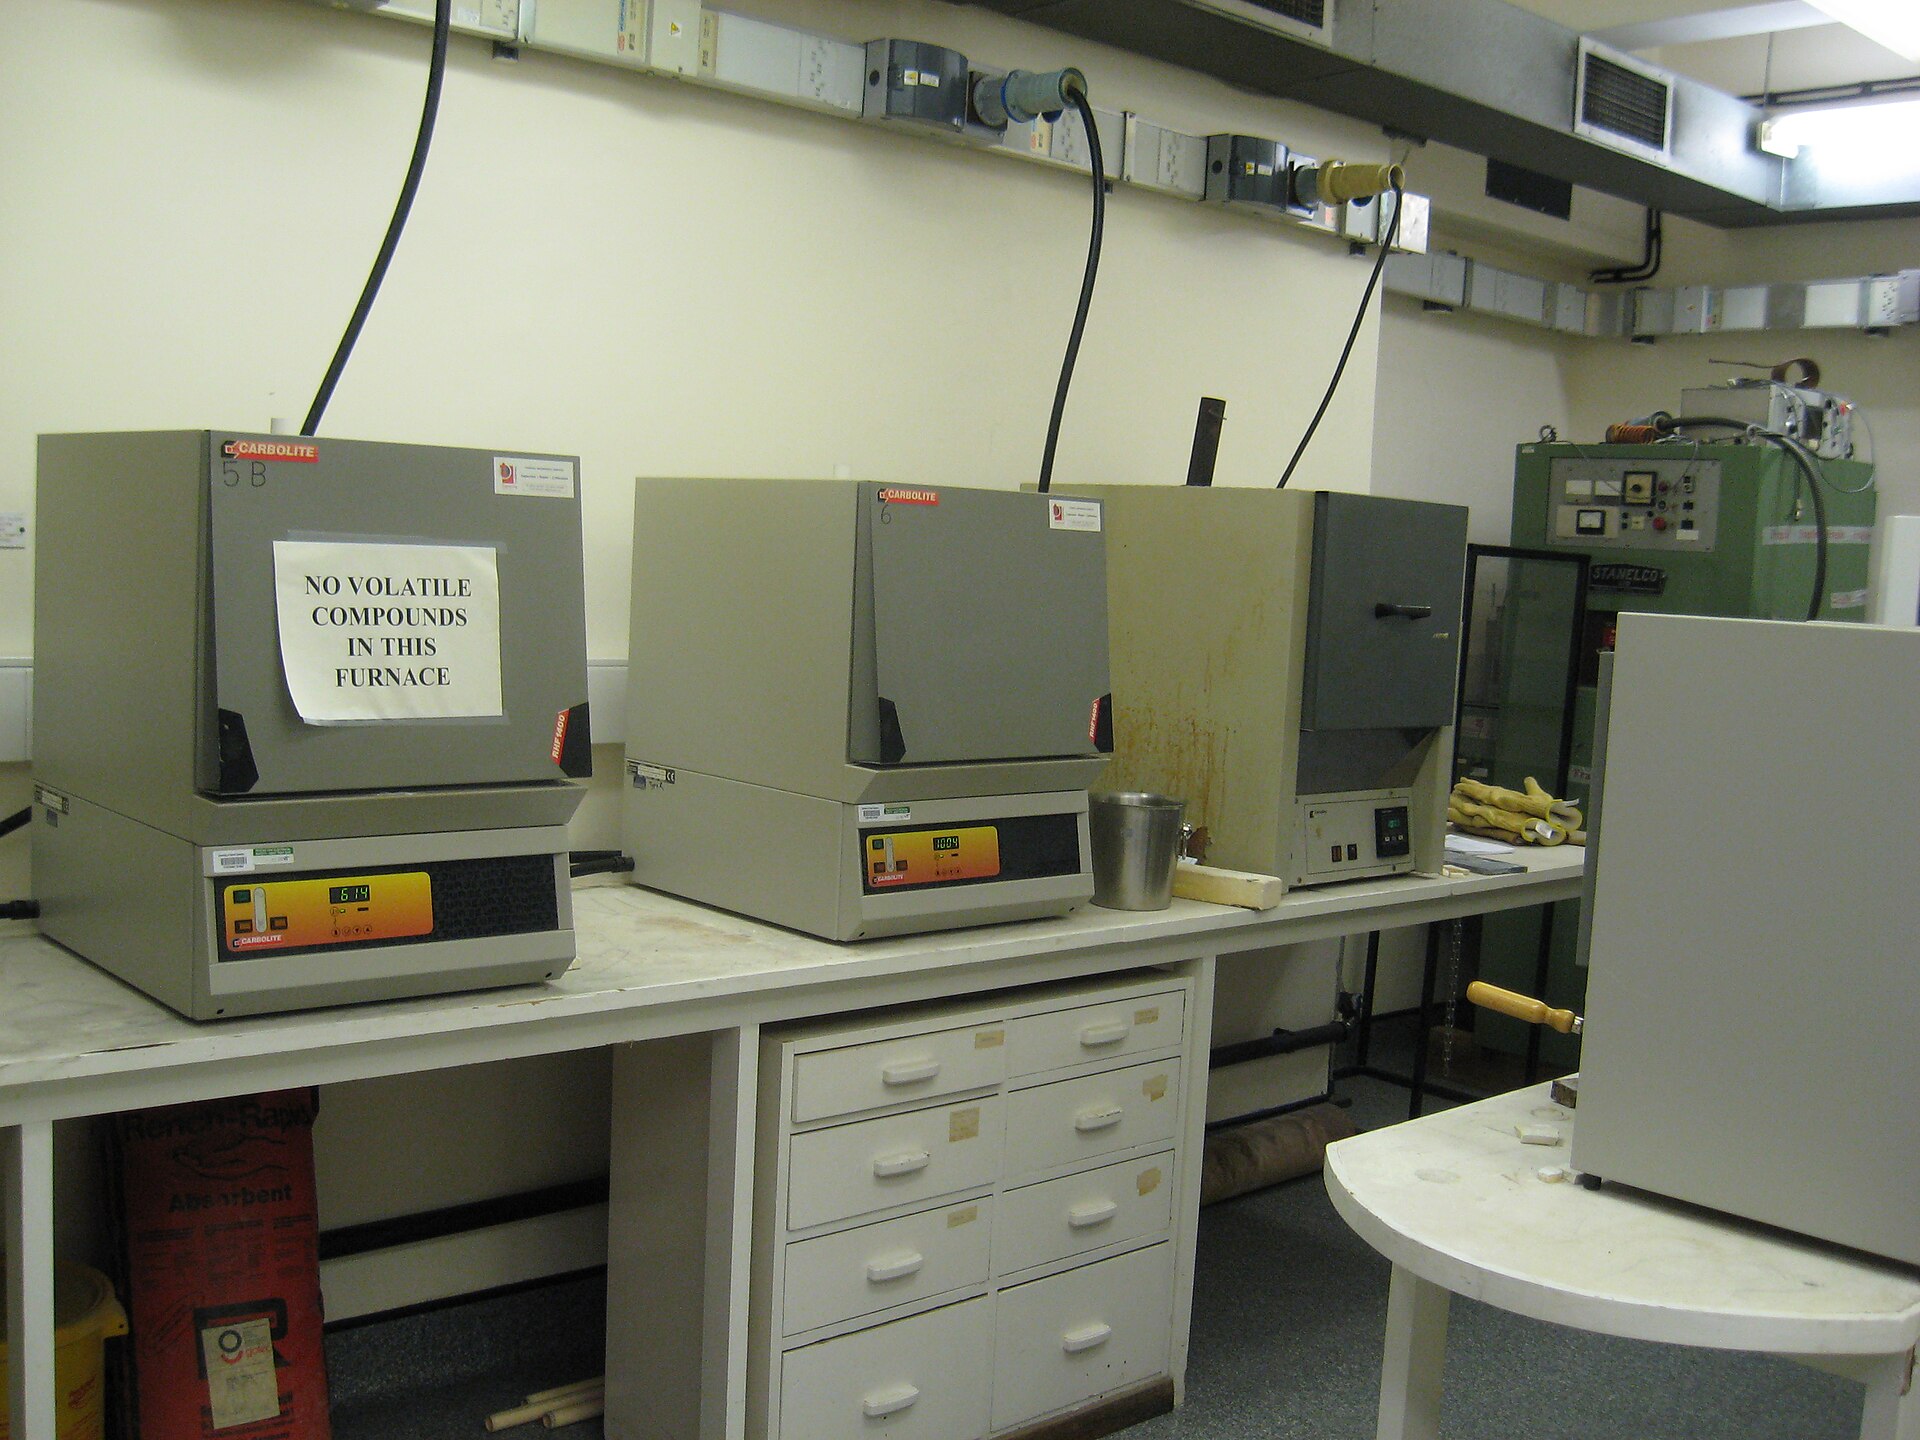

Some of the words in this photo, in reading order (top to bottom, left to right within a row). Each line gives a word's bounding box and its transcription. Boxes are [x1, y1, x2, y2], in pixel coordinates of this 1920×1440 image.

[239, 442, 315, 458] CARBOLITE
[888, 489, 936, 502] CARBOLITE
[880, 504, 892, 525] 6
[305, 575, 341, 596] NO
[347, 576, 472, 597] VOLATILE
[312, 606, 467, 627] COMPOUNDS
[348, 637, 374, 657] IN
[380, 637, 437, 657] THIS
[335, 667, 451, 687] FURNACE
[935, 836, 959, 849] 1004
[340, 886, 369, 901] 614
[241, 934, 283, 945] CARBOLITE
